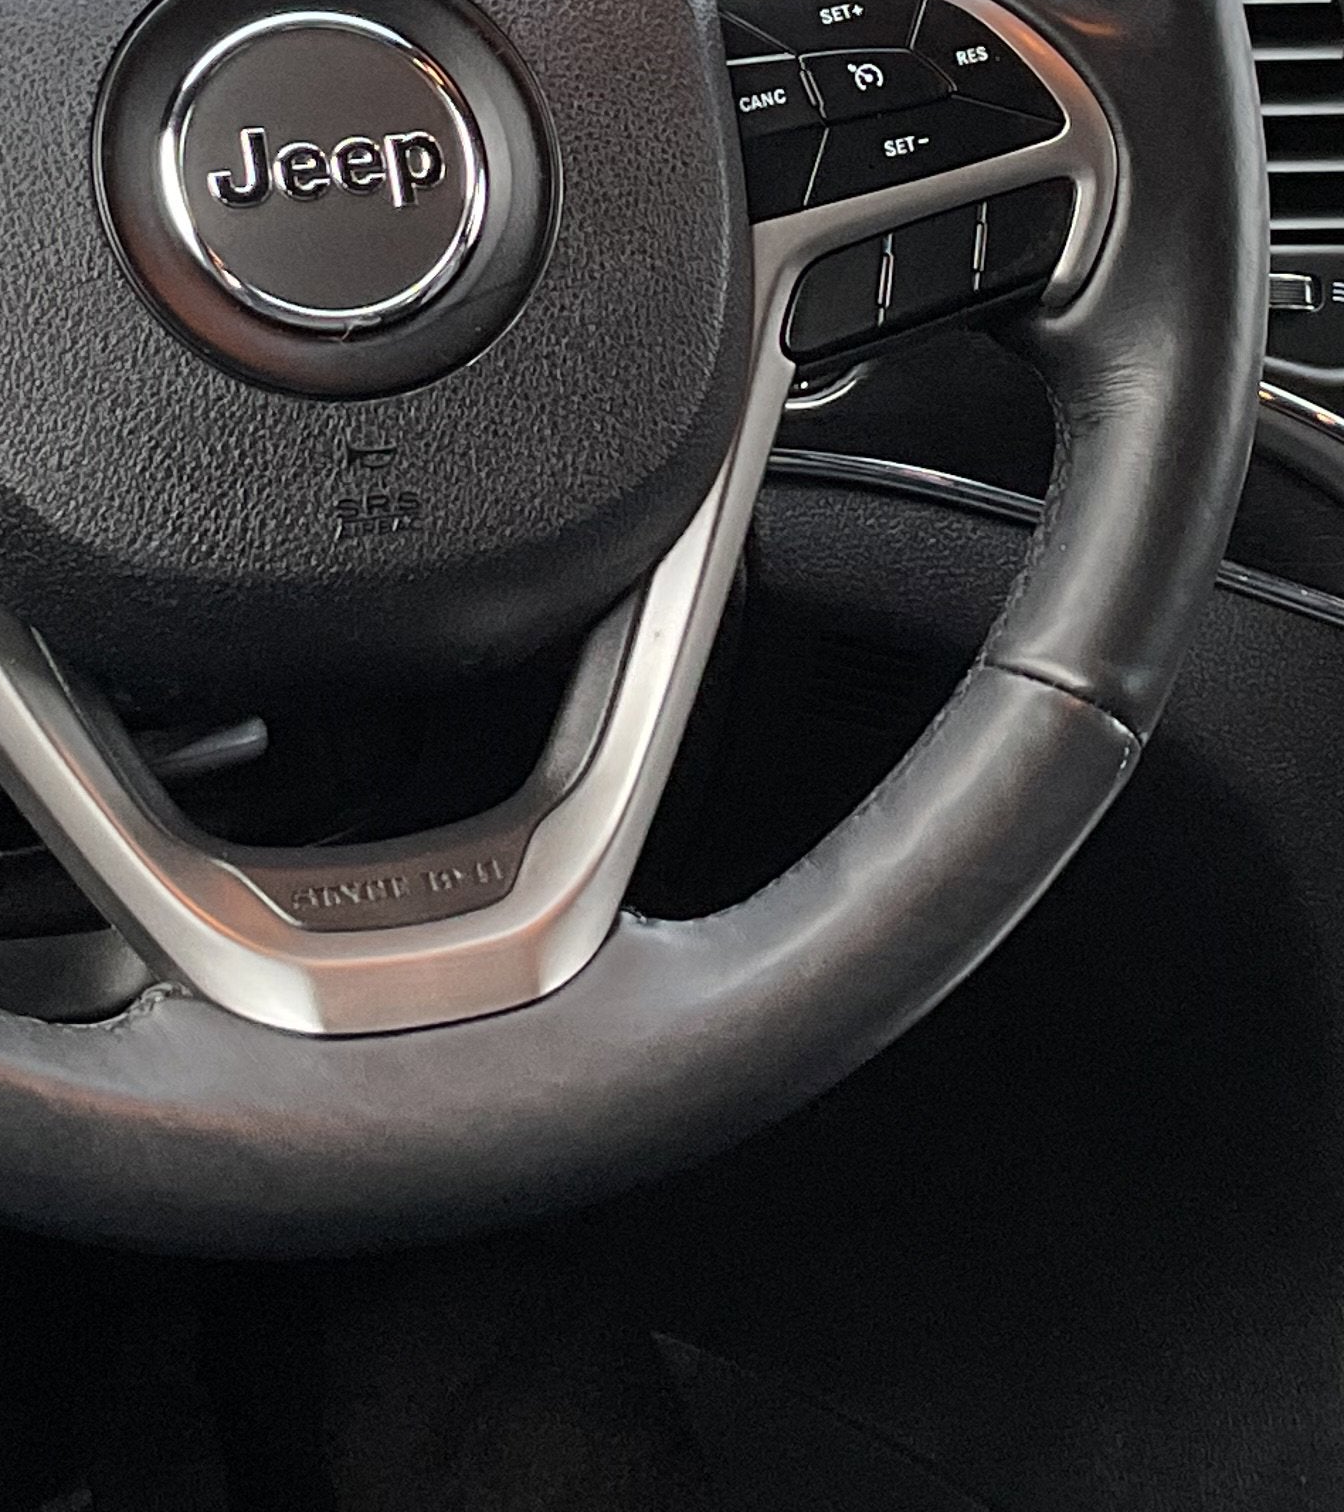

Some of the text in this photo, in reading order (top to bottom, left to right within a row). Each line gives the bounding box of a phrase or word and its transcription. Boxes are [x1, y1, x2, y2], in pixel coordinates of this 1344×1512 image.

[956, 46, 989, 66] RES
[739, 89, 788, 113] CANC
[207, 126, 446, 208] Jeep
